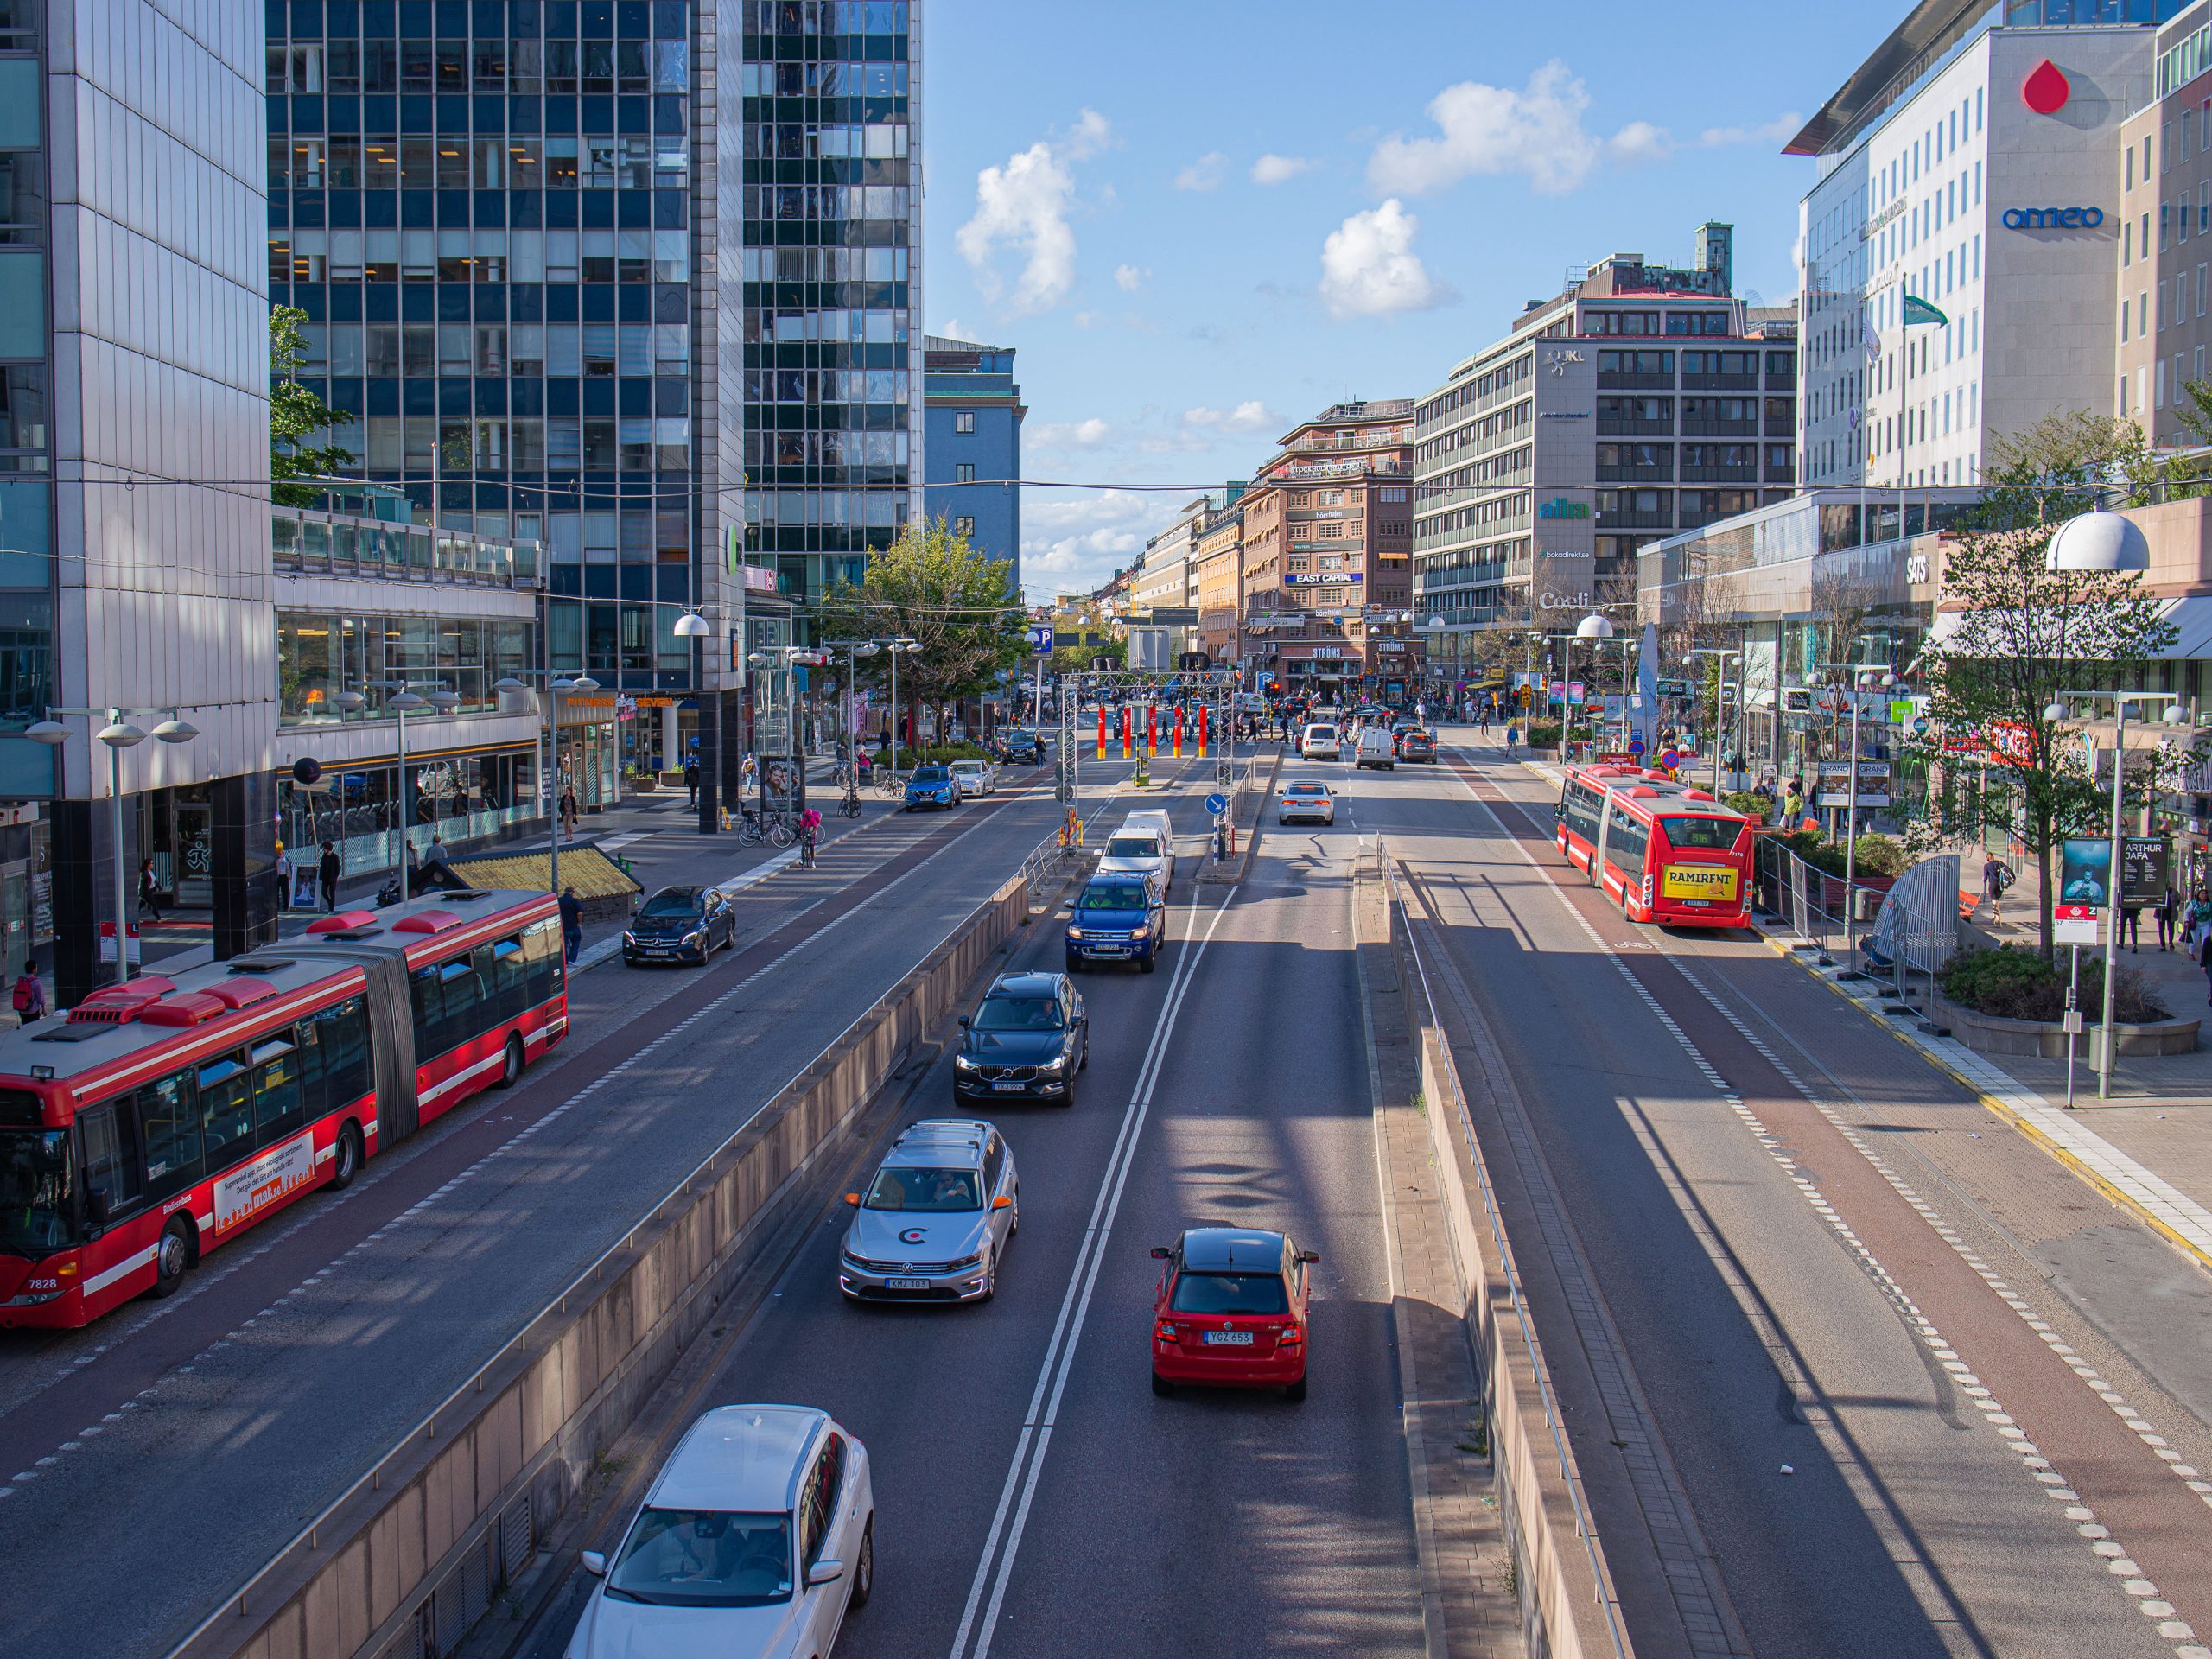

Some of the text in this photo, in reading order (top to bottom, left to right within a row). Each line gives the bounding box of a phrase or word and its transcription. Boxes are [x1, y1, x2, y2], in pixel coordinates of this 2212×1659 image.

[1539, 498, 1589, 519] allra
[1906, 555, 1929, 584] SATS
[1538, 592, 1589, 609] Coeli
[1313, 646, 1341, 658] STRÖMS
[1378, 641, 1405, 652] STRÖMS
[567, 697, 615, 708] FITNESS
[636, 697, 673, 708] SEVEN
[1692, 833, 1708, 843] 516
[2125, 843, 2162, 853] ARTHUR
[1669, 872, 1732, 885] RAMIRENT
[253, 1185, 281, 1208] mat.se
[29, 1279, 57, 1289] 7828
[1211, 1332, 1249, 1342] YGZ 653
